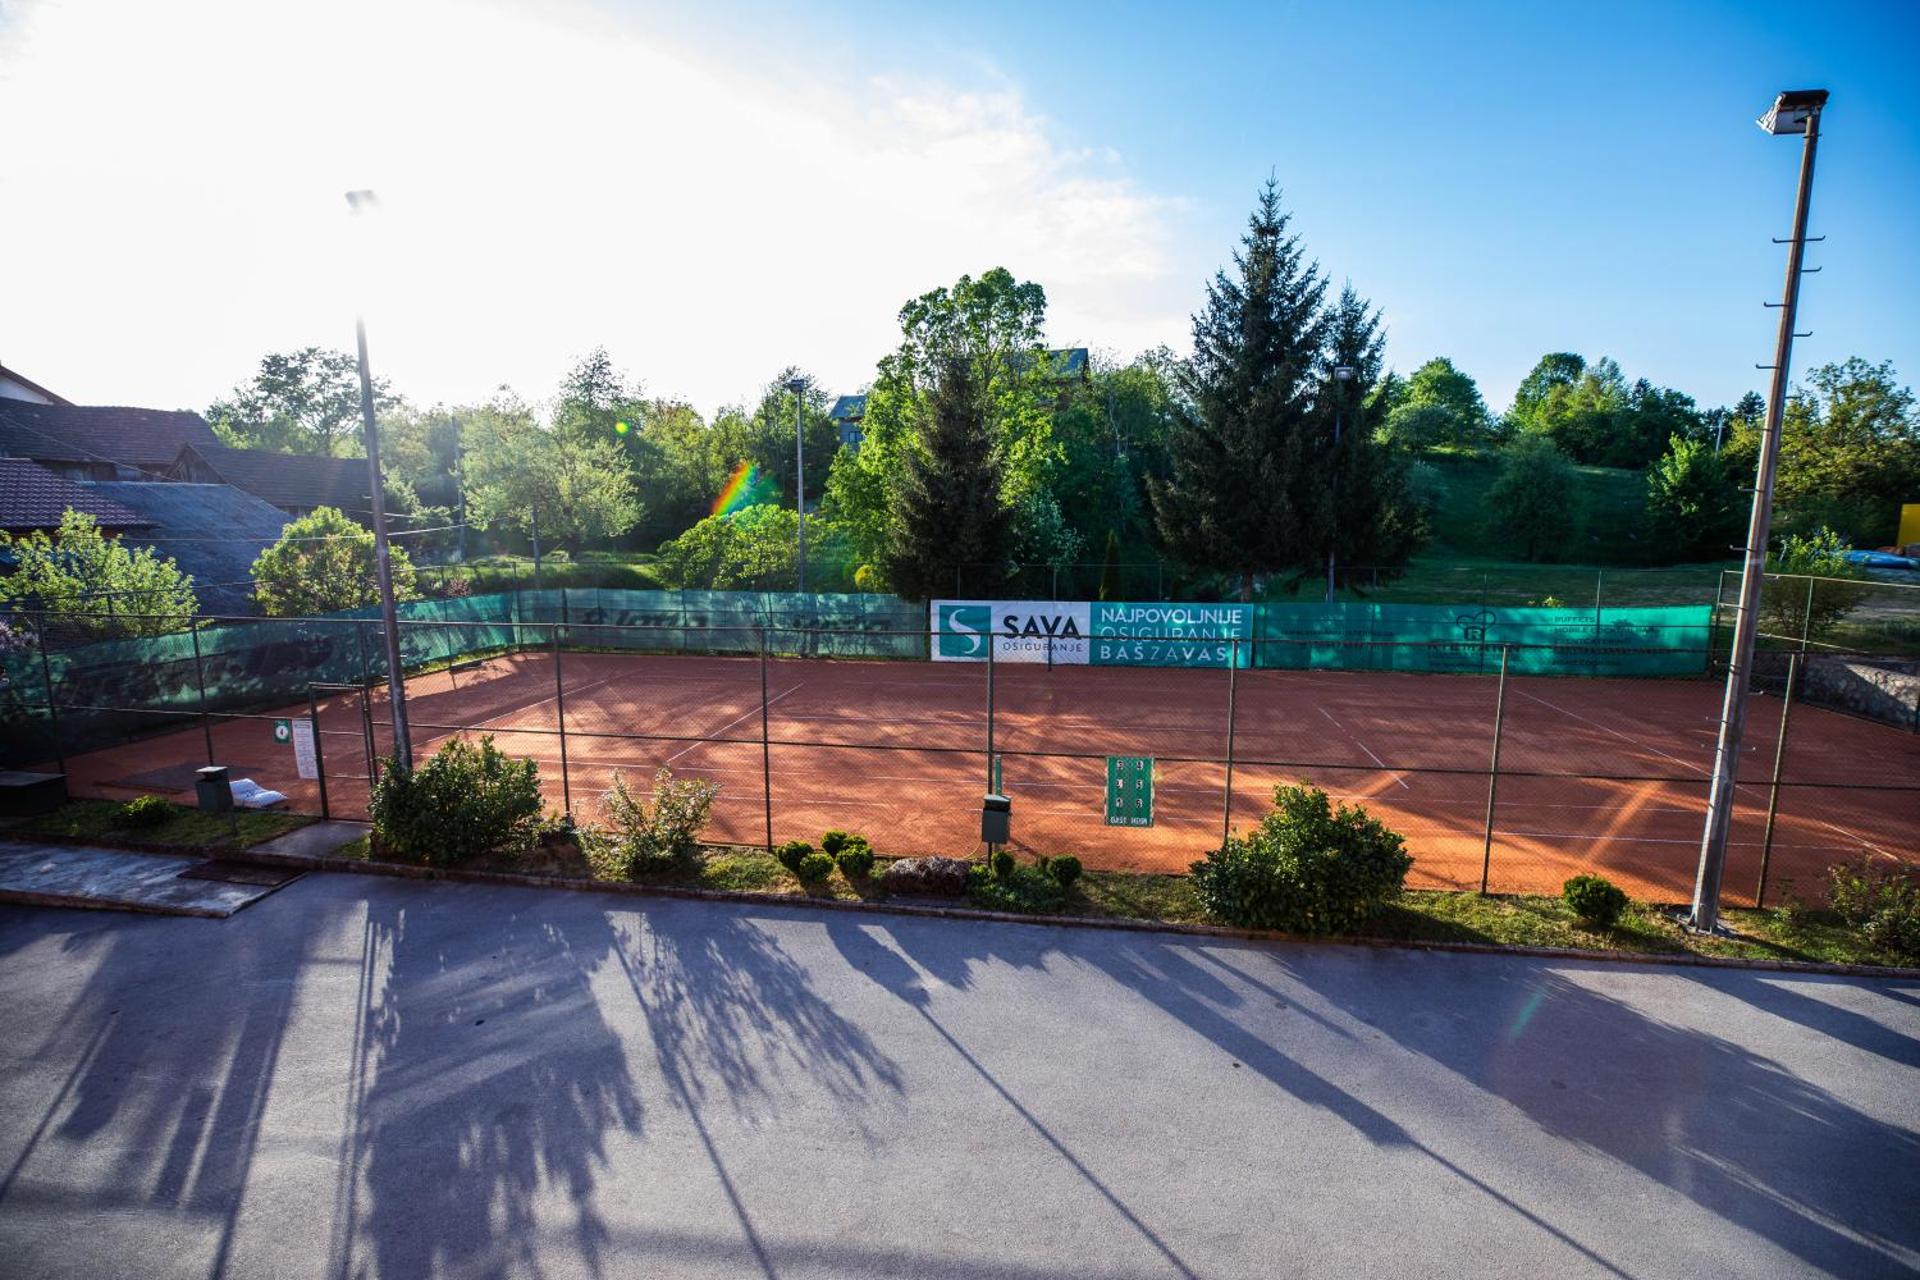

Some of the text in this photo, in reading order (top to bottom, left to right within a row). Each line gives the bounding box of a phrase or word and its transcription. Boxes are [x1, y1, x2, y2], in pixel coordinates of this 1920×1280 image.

[1101, 608, 1243, 624] NAJPOVOLJNIJE
[1003, 615, 1081, 640] SAVA
[1100, 626, 1241, 643] OSIGURANJE
[1002, 641, 1083, 652] OSIGURANJE
